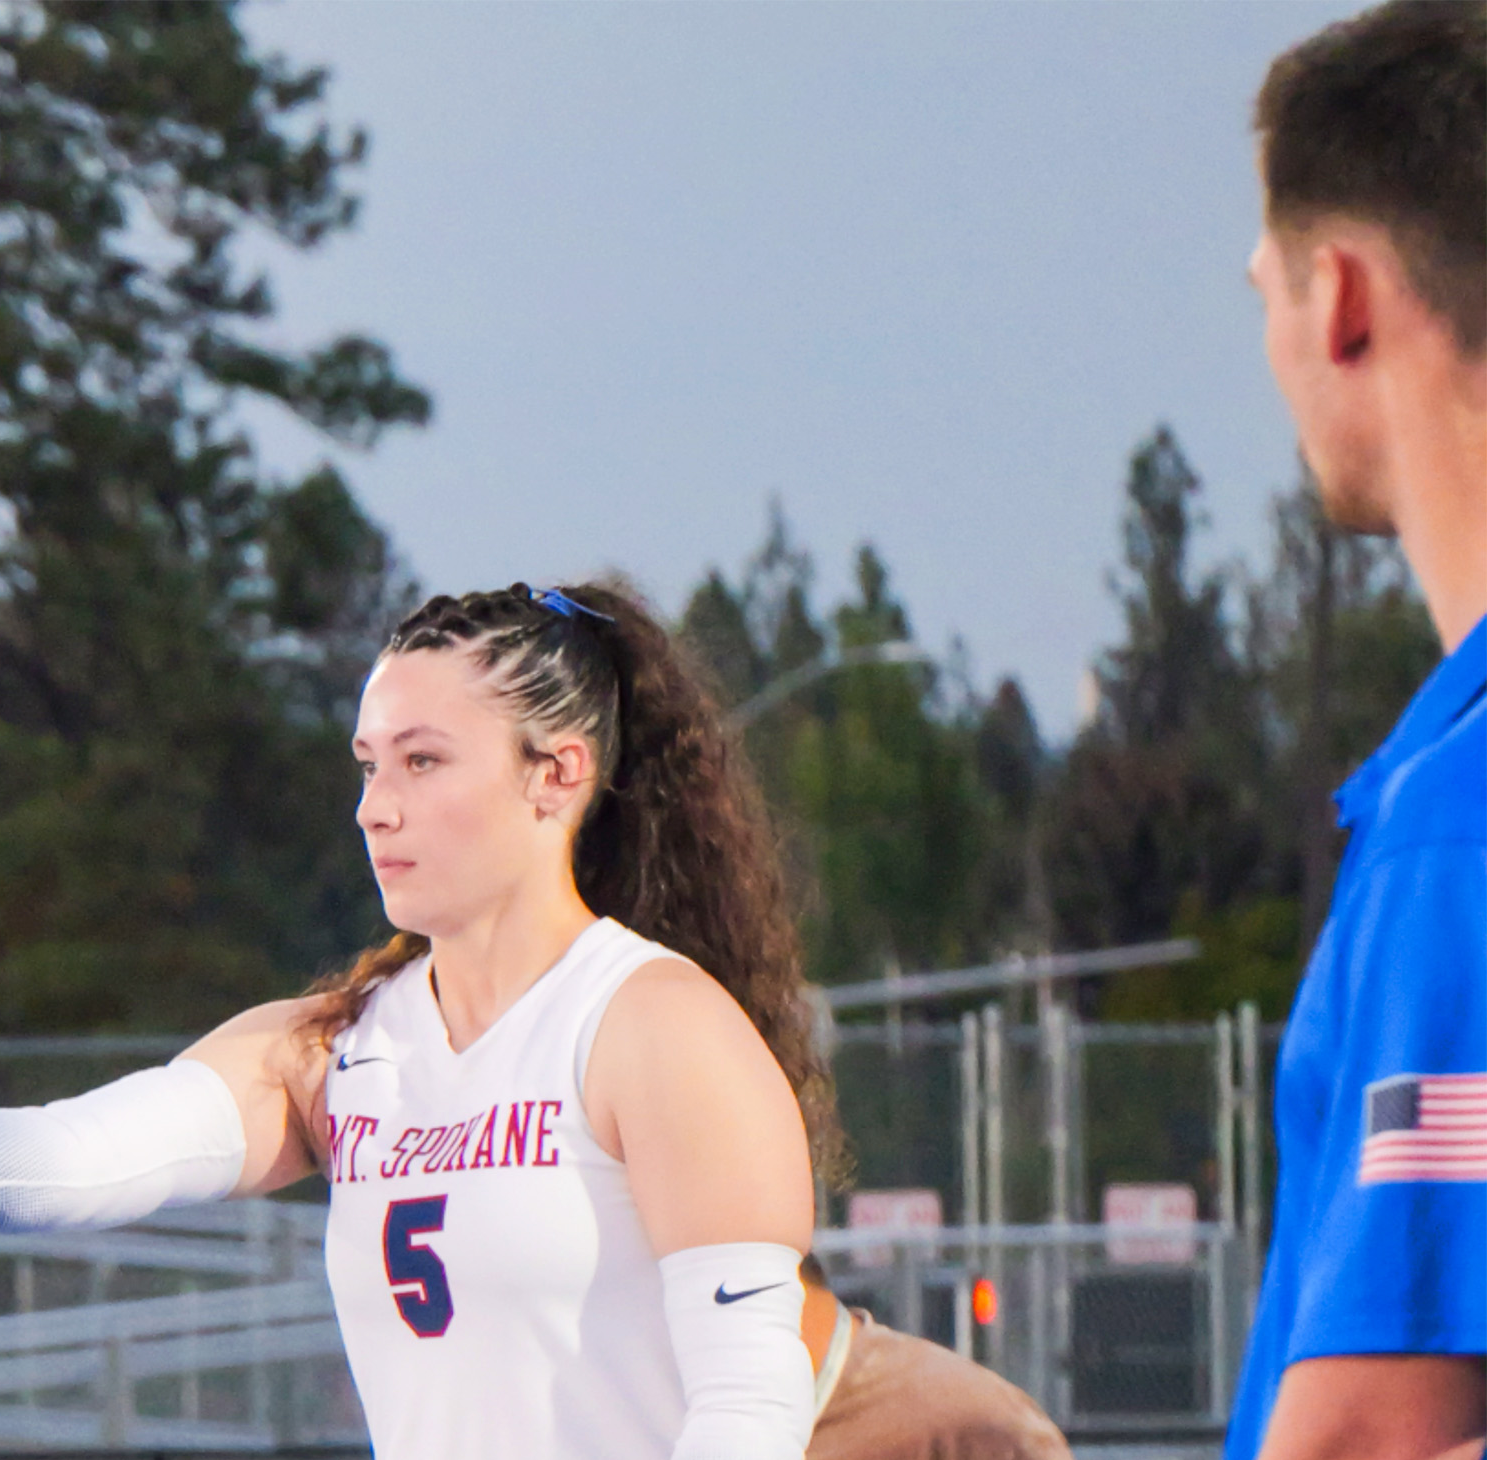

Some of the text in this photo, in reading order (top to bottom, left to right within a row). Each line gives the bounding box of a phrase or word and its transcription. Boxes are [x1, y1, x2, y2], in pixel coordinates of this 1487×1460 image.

[327, 1100, 563, 1185] MT. SPOKANE
[381, 1193, 455, 1339] 5
